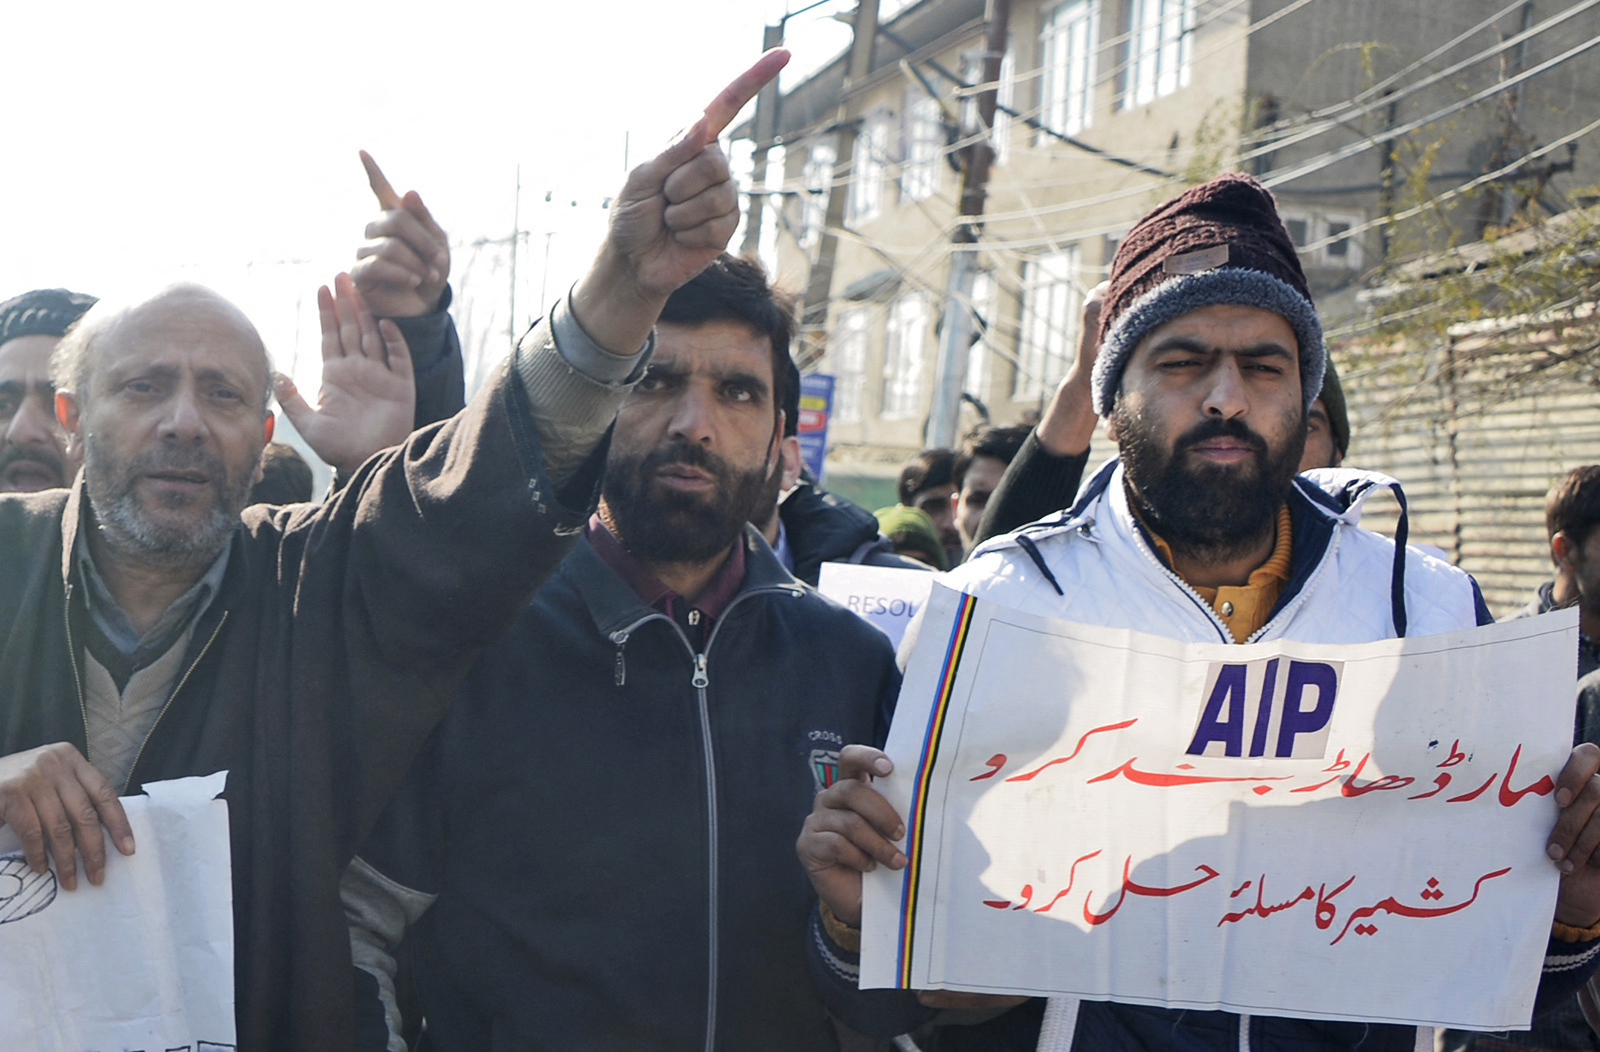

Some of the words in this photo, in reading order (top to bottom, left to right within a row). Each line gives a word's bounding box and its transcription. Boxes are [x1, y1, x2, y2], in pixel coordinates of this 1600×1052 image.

[1185, 658, 1339, 757] AIP
[969, 718, 1138, 782] کرو
[1087, 757, 1294, 795] بند
[1084, 855, 1220, 925] حل
[1315, 876, 1355, 930] کا
[1330, 867, 1511, 945] کشمیر
